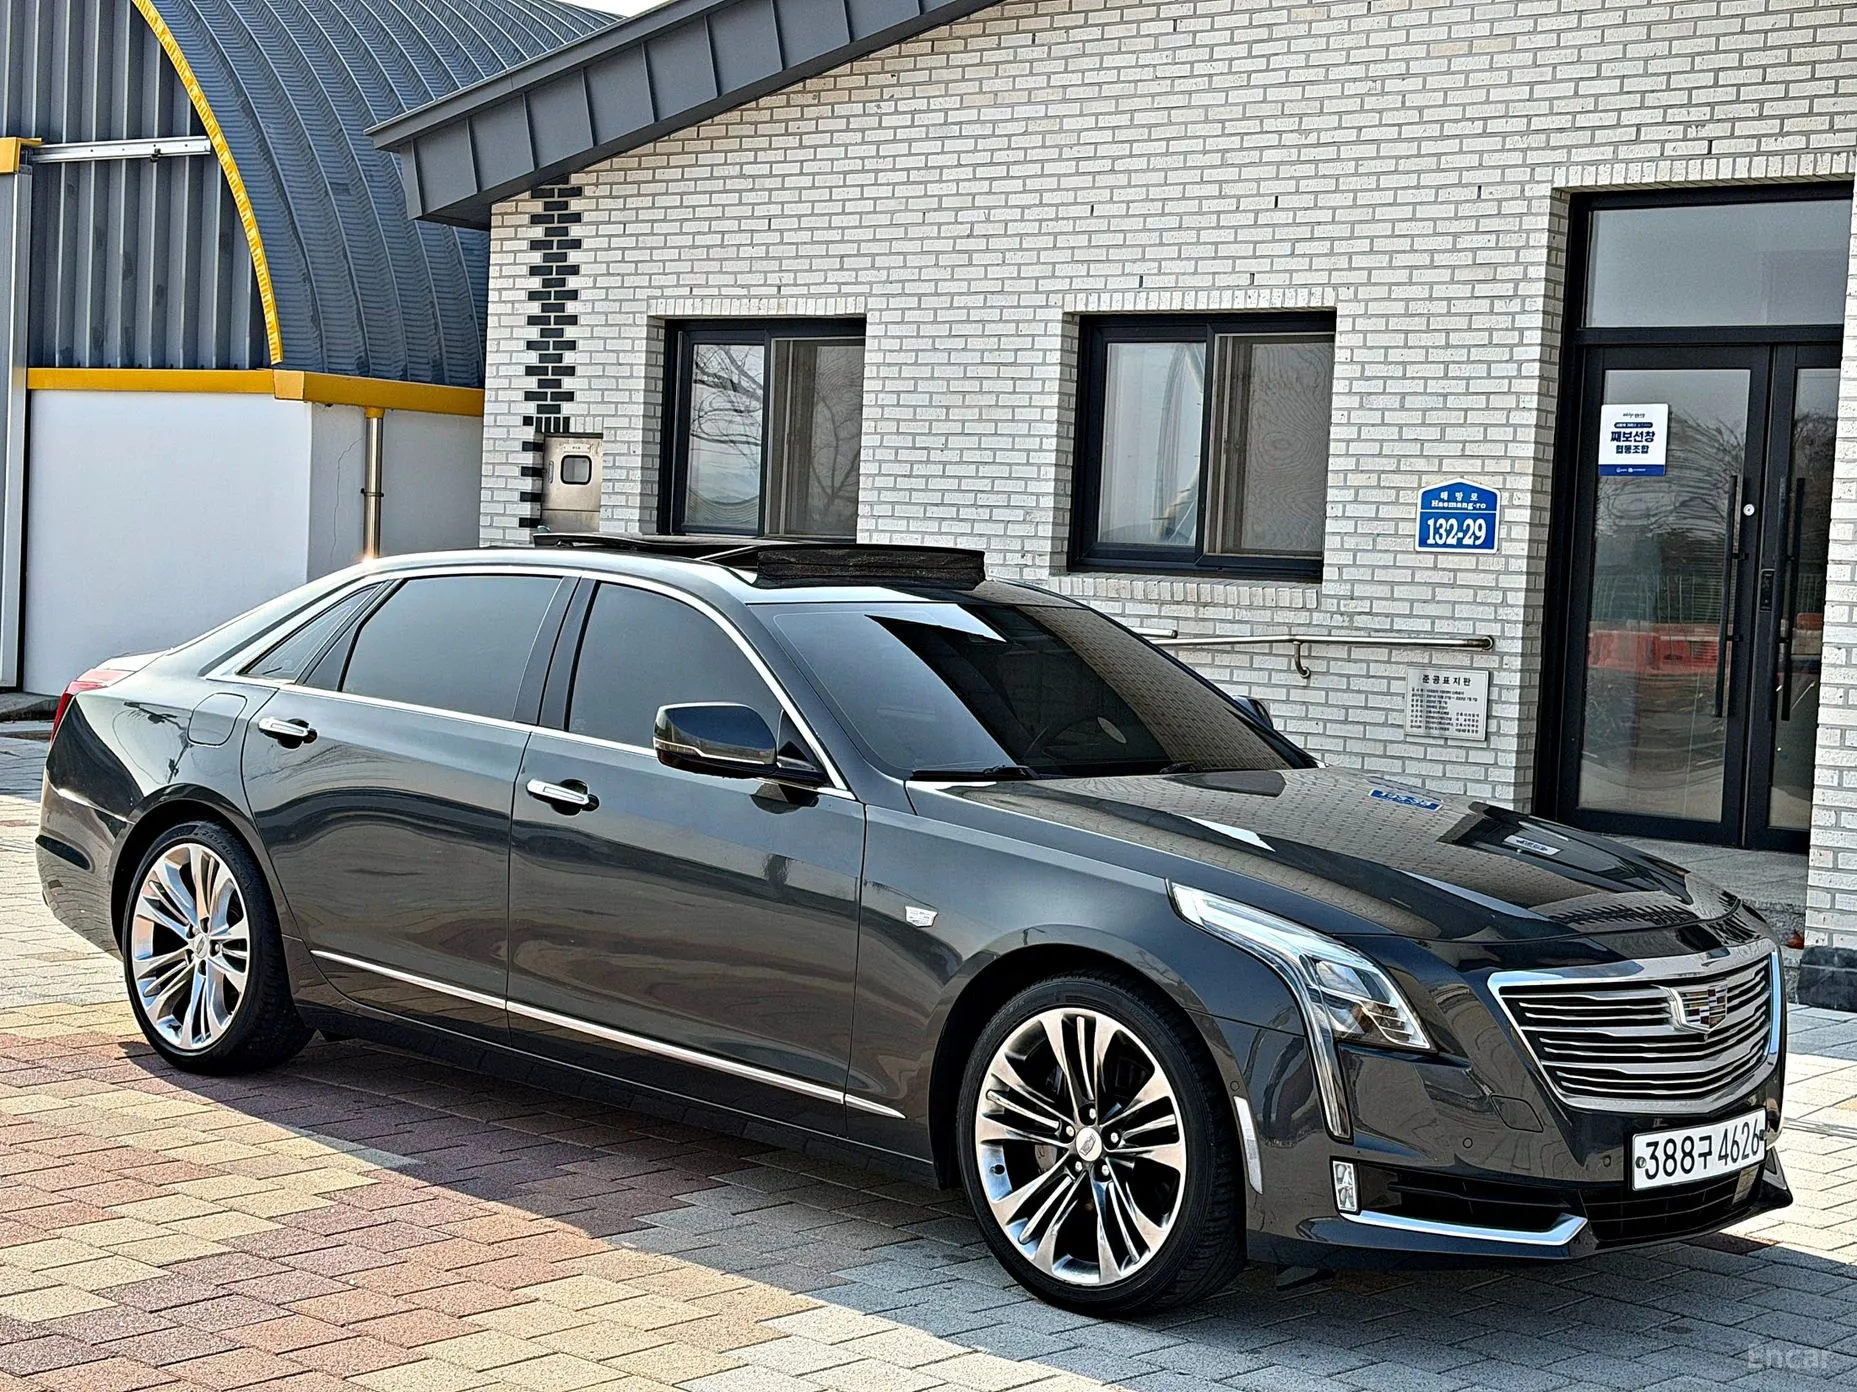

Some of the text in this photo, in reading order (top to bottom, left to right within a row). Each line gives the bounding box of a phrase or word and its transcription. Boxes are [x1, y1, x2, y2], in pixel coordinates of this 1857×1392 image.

[1610, 430, 1656, 443] 째보선창
[1615, 444, 1650, 455] 협동조합
[1431, 500, 1487, 510] Haemang-ro
[1426, 517, 1487, 545] 132-29
[1422, 674, 1471, 686] 준공표지판
[1645, 1118, 1761, 1180] 388구 4626
